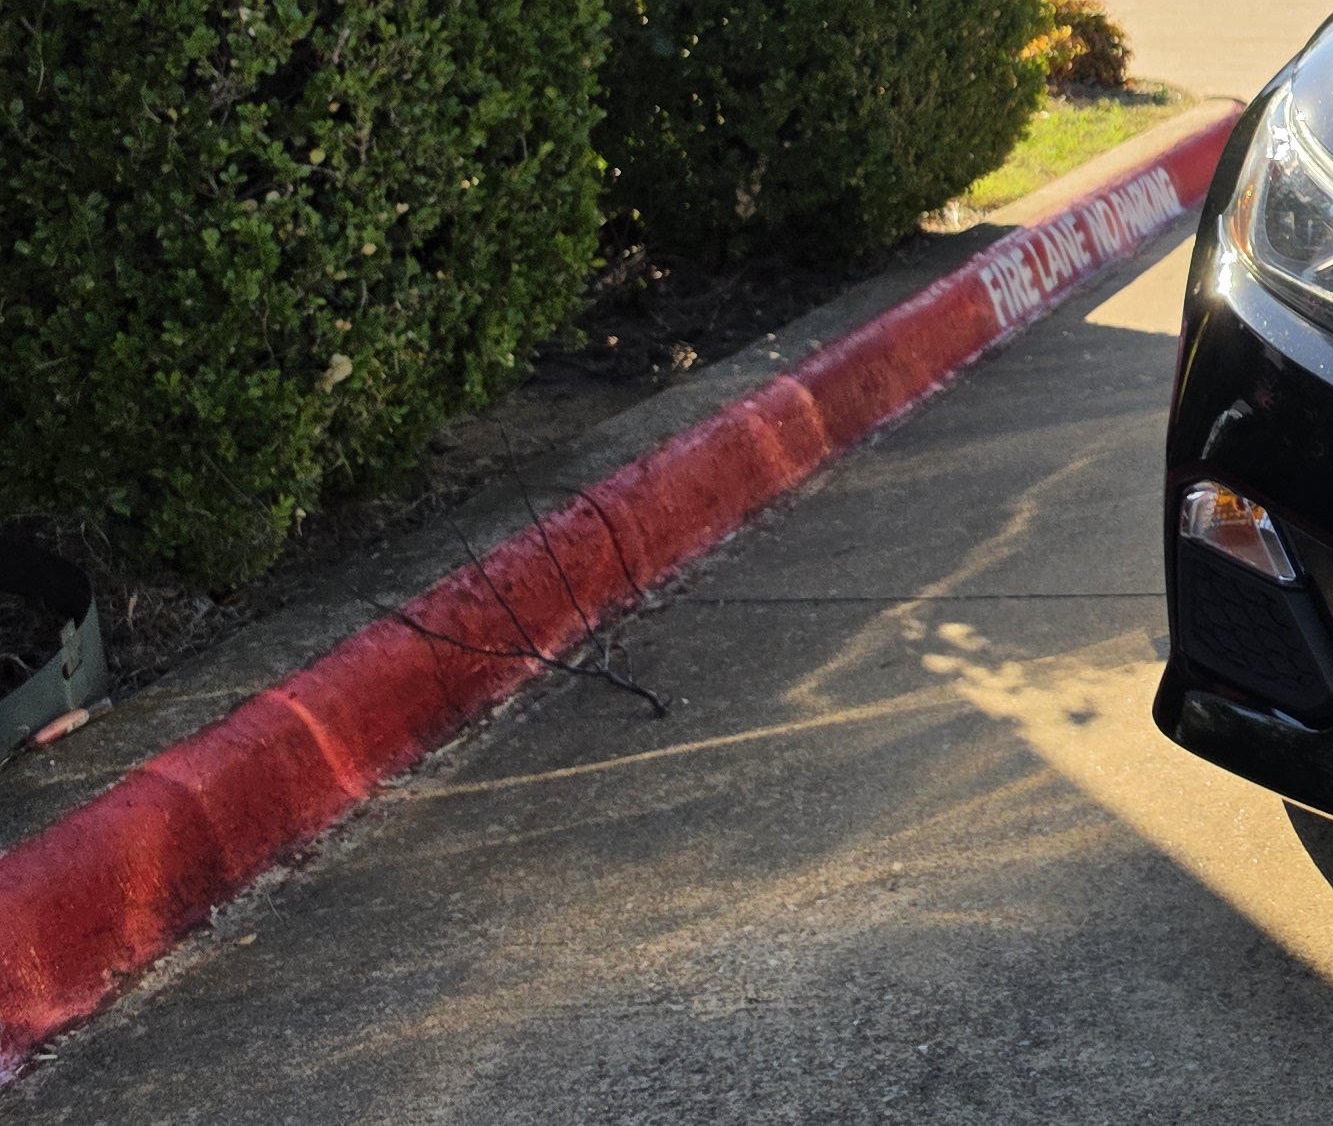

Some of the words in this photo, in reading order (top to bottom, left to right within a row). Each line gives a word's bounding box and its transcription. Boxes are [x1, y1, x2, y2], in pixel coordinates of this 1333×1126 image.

[980, 247, 1042, 327] FIRE
[1024, 210, 1092, 293] LANE
[1082, 199, 1122, 257] NO
[1110, 166, 1185, 245] PARKING
